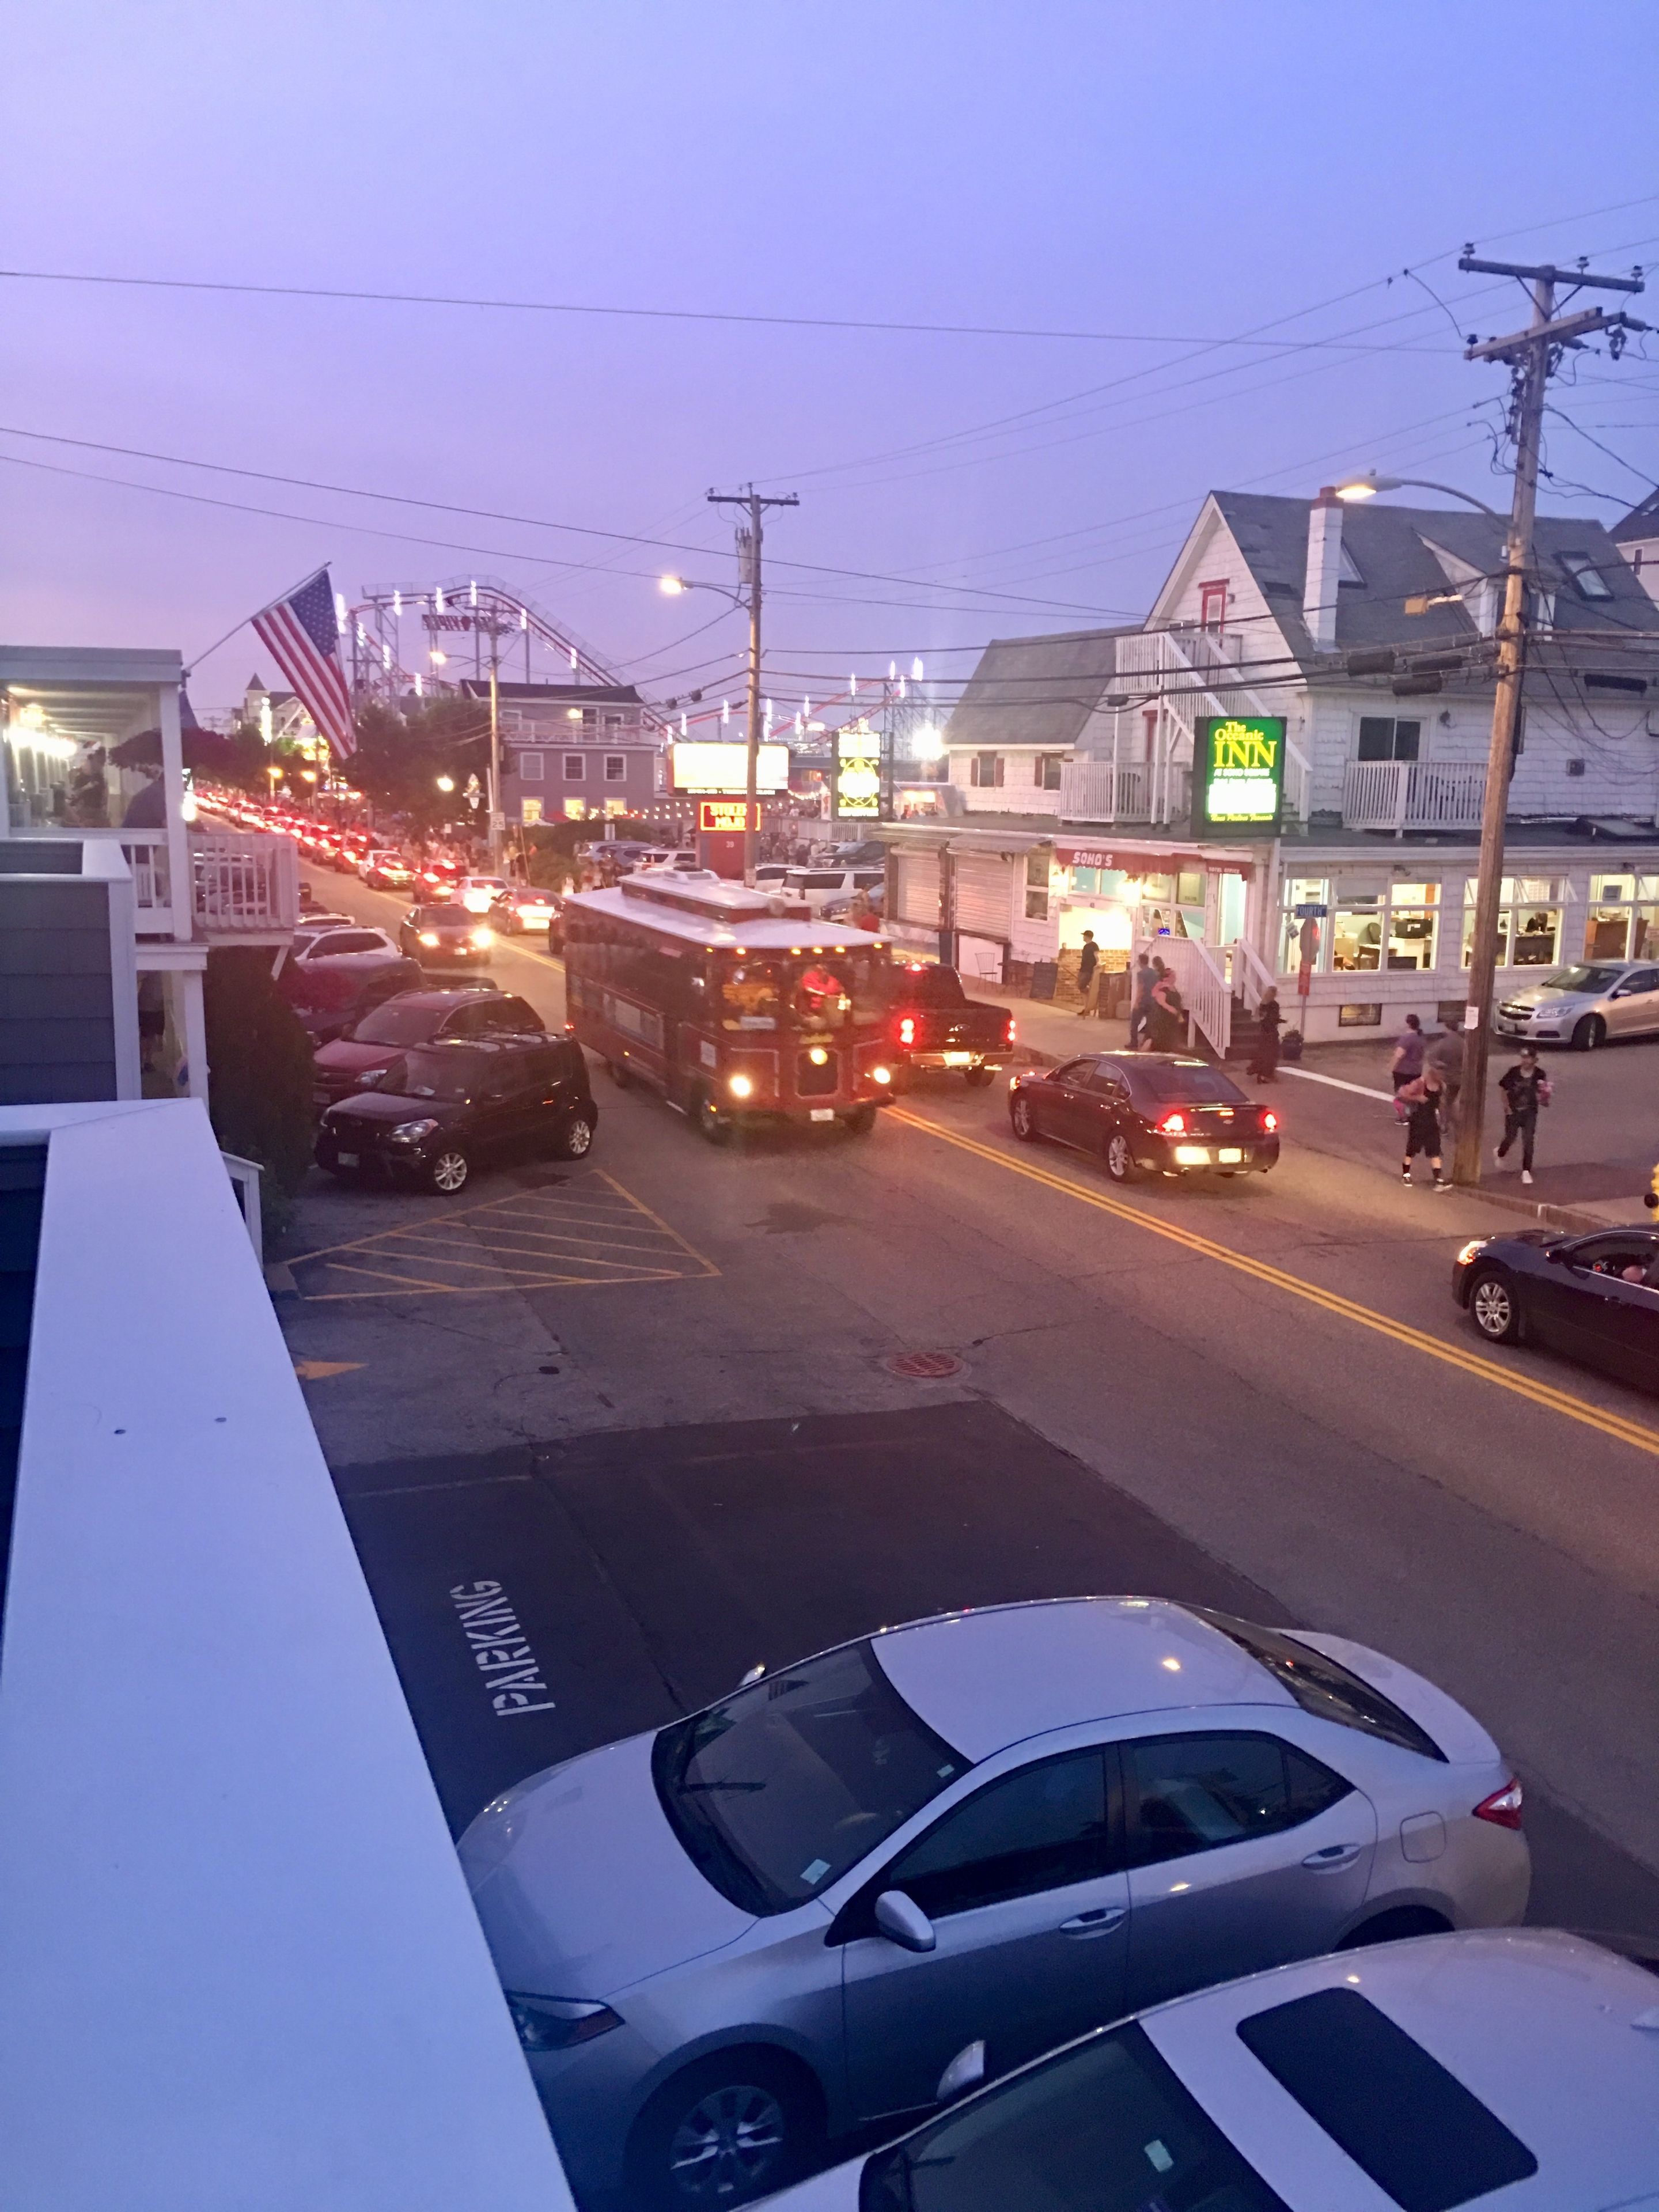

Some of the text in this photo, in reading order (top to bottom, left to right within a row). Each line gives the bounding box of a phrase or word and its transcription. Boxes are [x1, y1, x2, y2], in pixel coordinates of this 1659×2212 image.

[1225, 721, 1247, 732] The
[1214, 728, 1264, 741] Oceanic
[1213, 741, 1277, 768] INN
[710, 806, 747, 816] STOLE
[1072, 851, 1113, 867] SOHO'S
[1297, 906, 1323, 916] FOURTH
[450, 1581, 556, 1716] PARKING
